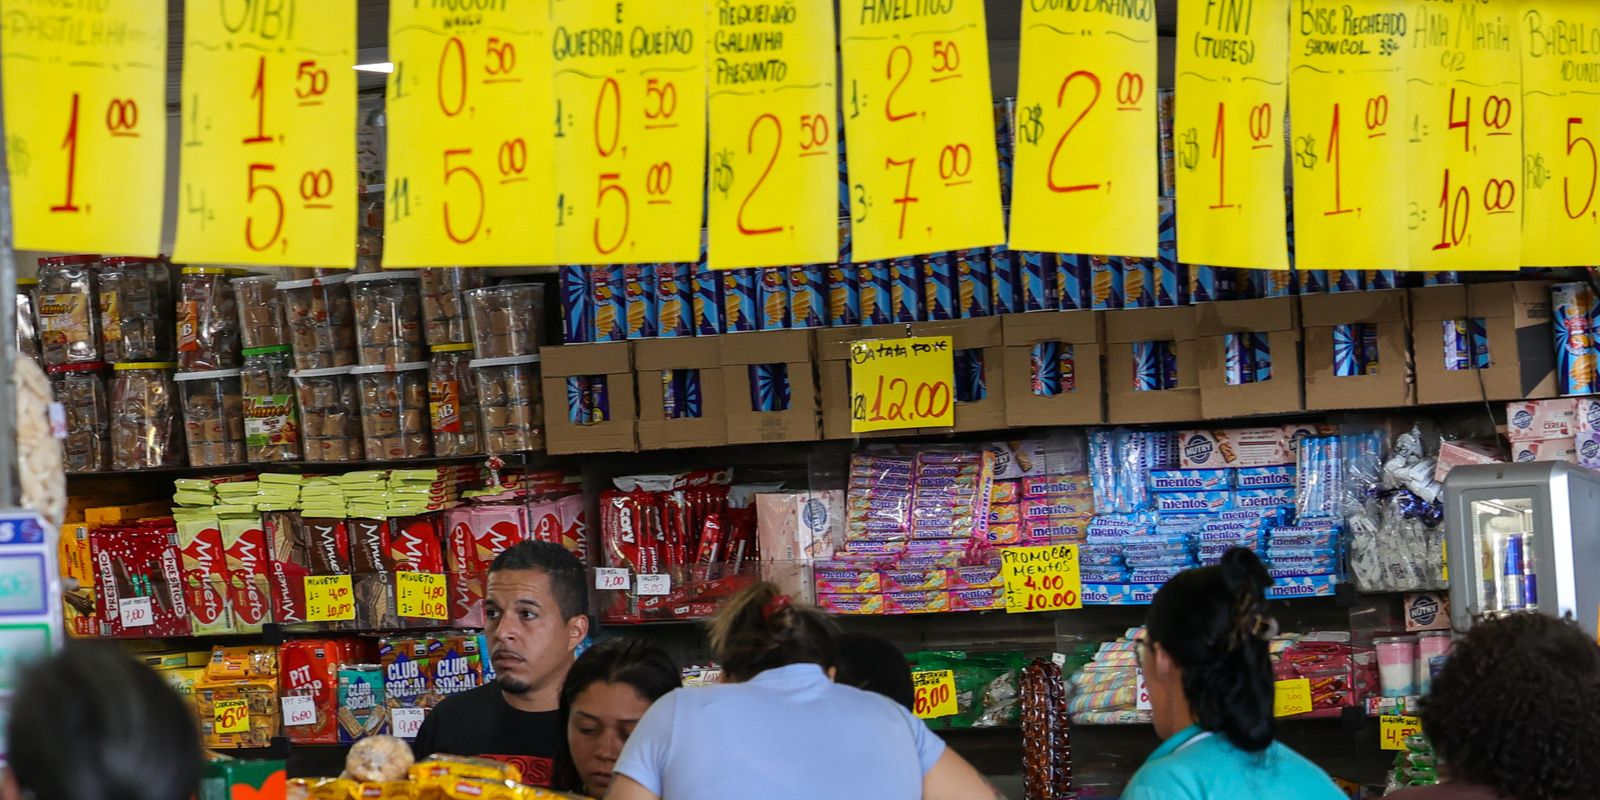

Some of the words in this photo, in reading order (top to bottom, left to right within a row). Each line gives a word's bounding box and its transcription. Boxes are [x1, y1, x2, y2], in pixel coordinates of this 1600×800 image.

[615, 2, 623, 24] E
[1412, 5, 1449, 49] ANA
[552, 26, 623, 61] QUEBRA
[630, 26, 694, 59] QUEIXO
[714, 30, 783, 54] GALINHA
[1194, 31, 1255, 65] (TUBES)
[716, 58, 788, 85] PRESUNTO
[1544, 421, 1568, 429] CEREAL
[1185, 441, 1213, 457] NUTRY
[1156, 477, 1203, 488] mentos
[1243, 474, 1289, 485] mentos
[1031, 482, 1076, 494] mentos
[1029, 504, 1076, 516] mentos
[1163, 499, 1208, 509] mentos
[1222, 510, 1260, 519] mentos
[1032, 525, 1078, 536] mentos
[1091, 527, 1130, 537] mentos
[1207, 522, 1245, 531] mentos
[1203, 531, 1241, 540] mentos
[360, 523, 388, 583] Minueto
[455, 525, 471, 613] Minueto
[100, 553, 118, 612] PRESTIGIO
[164, 556, 185, 615] PRESTIGIO
[192, 536, 218, 621] Minueto
[236, 536, 262, 621] Minueto
[307, 577, 339, 586] MINUETO
[401, 573, 434, 584] MINUETO
[1080, 592, 1108, 601] entos
[1272, 585, 1314, 595] mentos
[1411, 604, 1438, 618] NUTRY
[387, 660, 419, 681] CLUB
[437, 657, 468, 677] CLUB
[289, 665, 311, 687] PIT
[435, 673, 477, 695] SOCIAL
[348, 682, 371, 697] CLUB
[385, 677, 429, 699] SOCIAL
[346, 694, 377, 710] SOCIAL
[915, 684, 949, 715] 6,00
